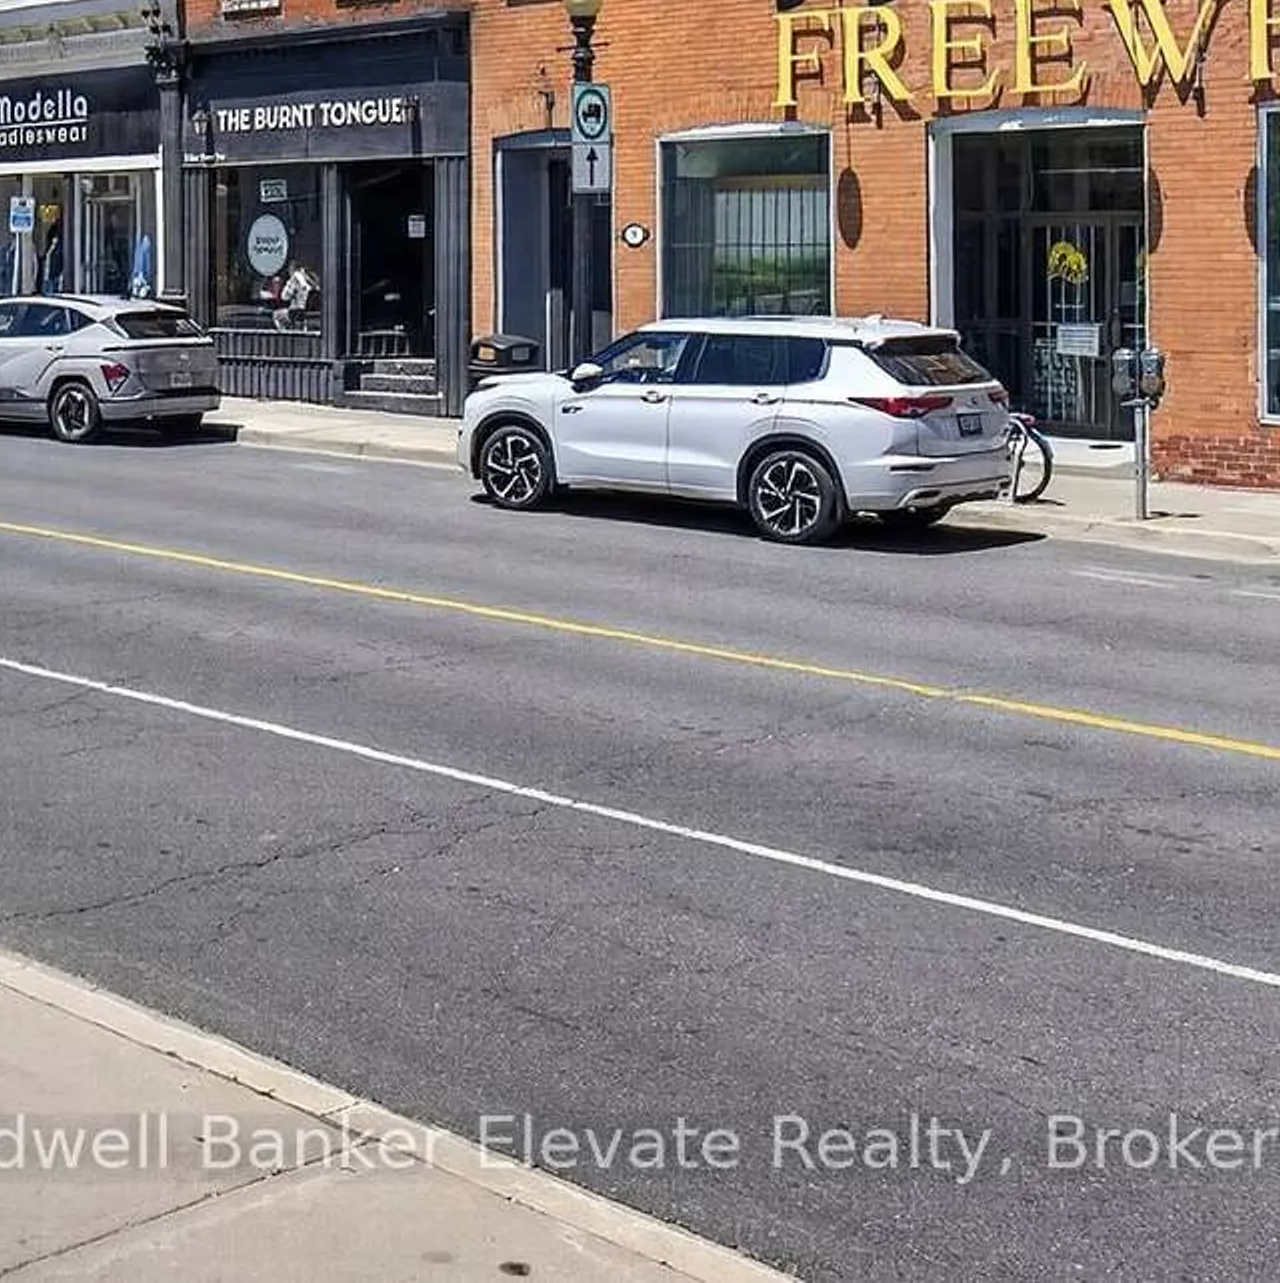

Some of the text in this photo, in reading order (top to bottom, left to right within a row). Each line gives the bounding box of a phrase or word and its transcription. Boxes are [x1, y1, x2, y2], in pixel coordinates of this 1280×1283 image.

[217, 98, 405, 133] THE BURNT TONGUE
